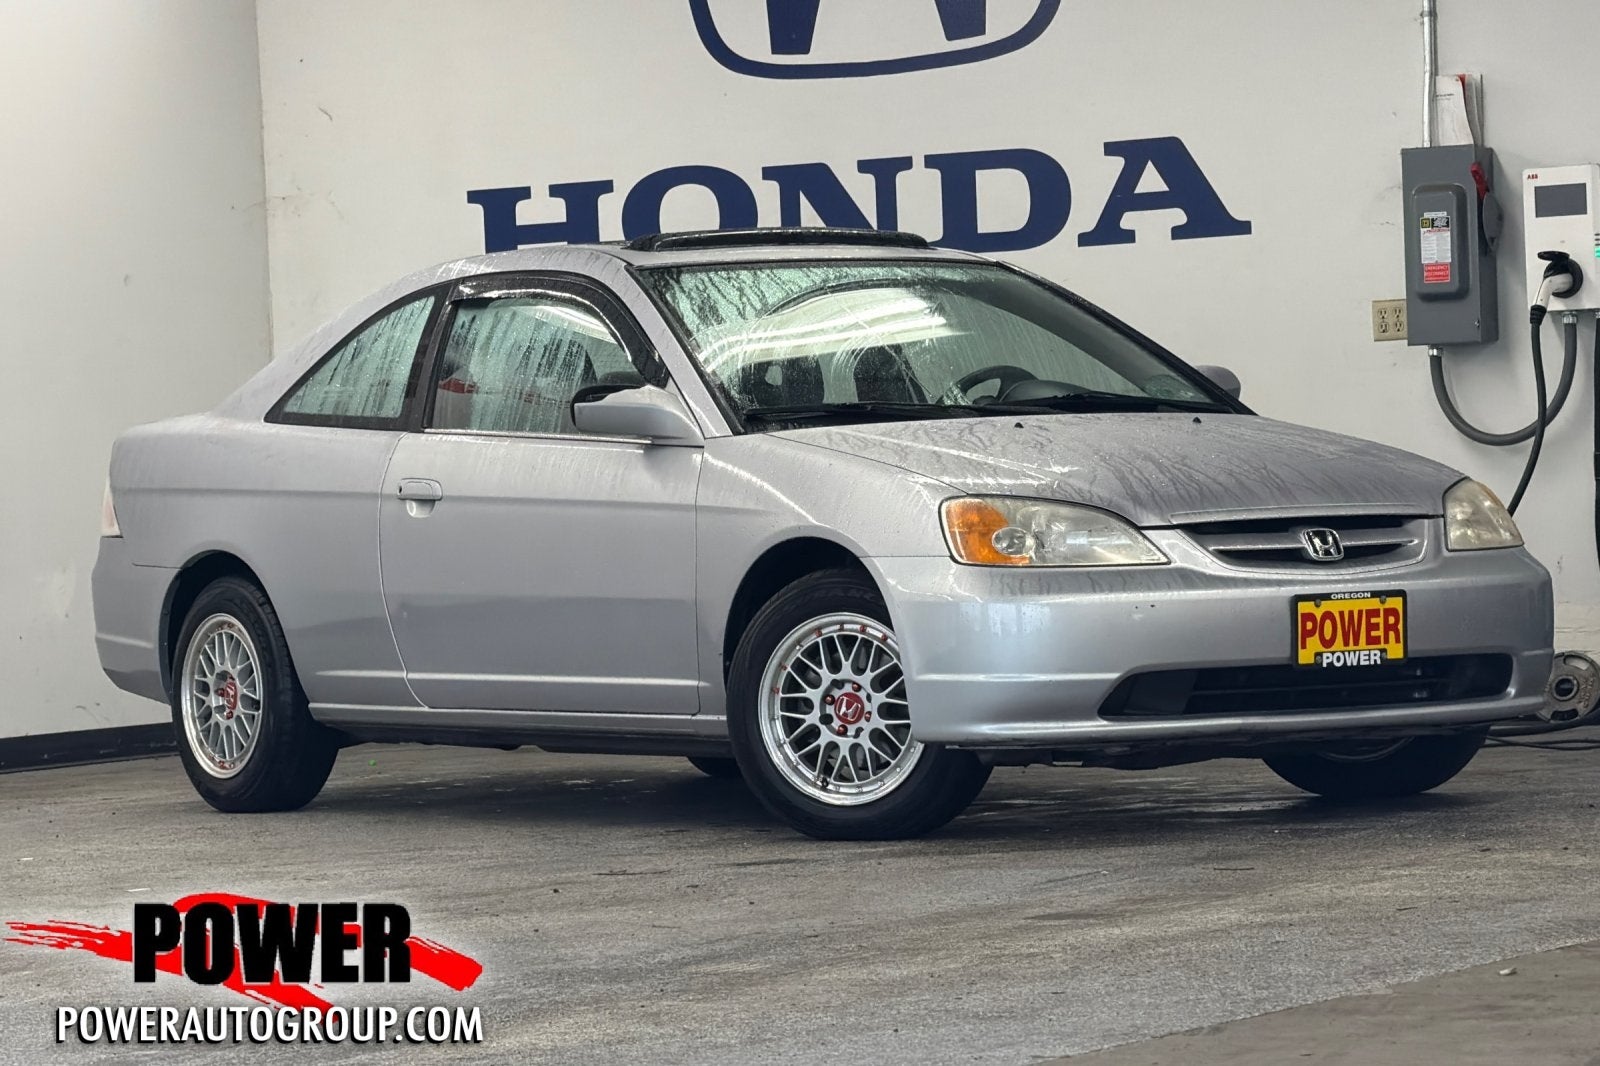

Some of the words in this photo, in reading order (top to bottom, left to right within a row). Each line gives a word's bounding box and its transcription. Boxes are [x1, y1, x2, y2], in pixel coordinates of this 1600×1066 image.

[466, 136, 1252, 253] HONDA
[1300, 607, 1401, 650] POWER
[1322, 650, 1381, 667] POWER
